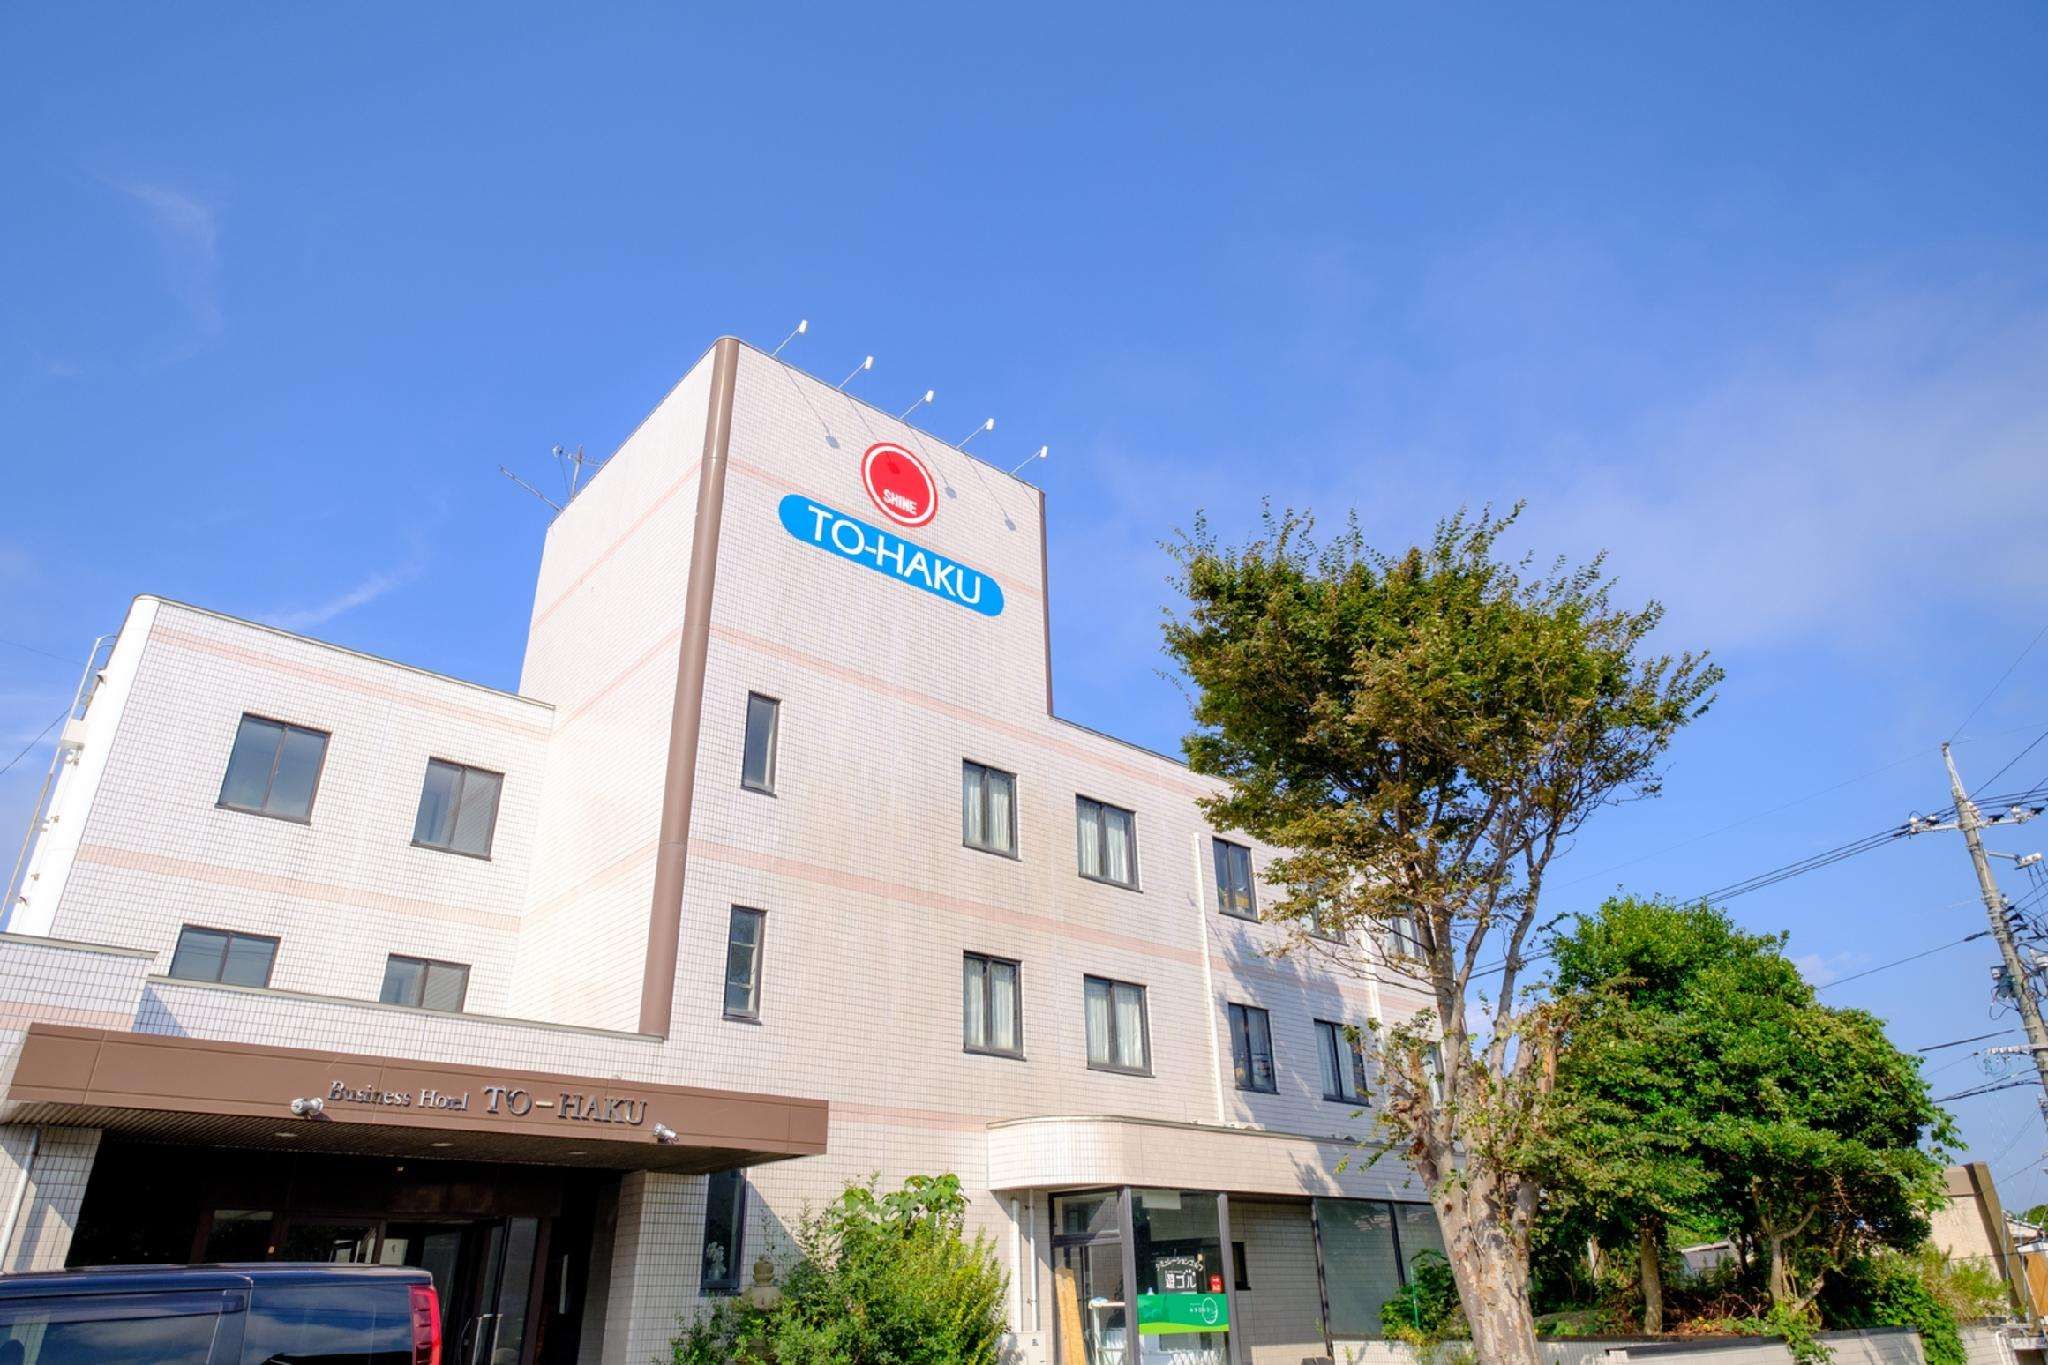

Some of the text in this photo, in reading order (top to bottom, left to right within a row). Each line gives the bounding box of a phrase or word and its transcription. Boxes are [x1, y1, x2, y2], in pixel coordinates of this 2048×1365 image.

[882, 488, 918, 516] SHINE
[808, 504, 981, 604] TO-HAKU
[328, 1080, 411, 1107] Business
[417, 1088, 470, 1111] Hotel
